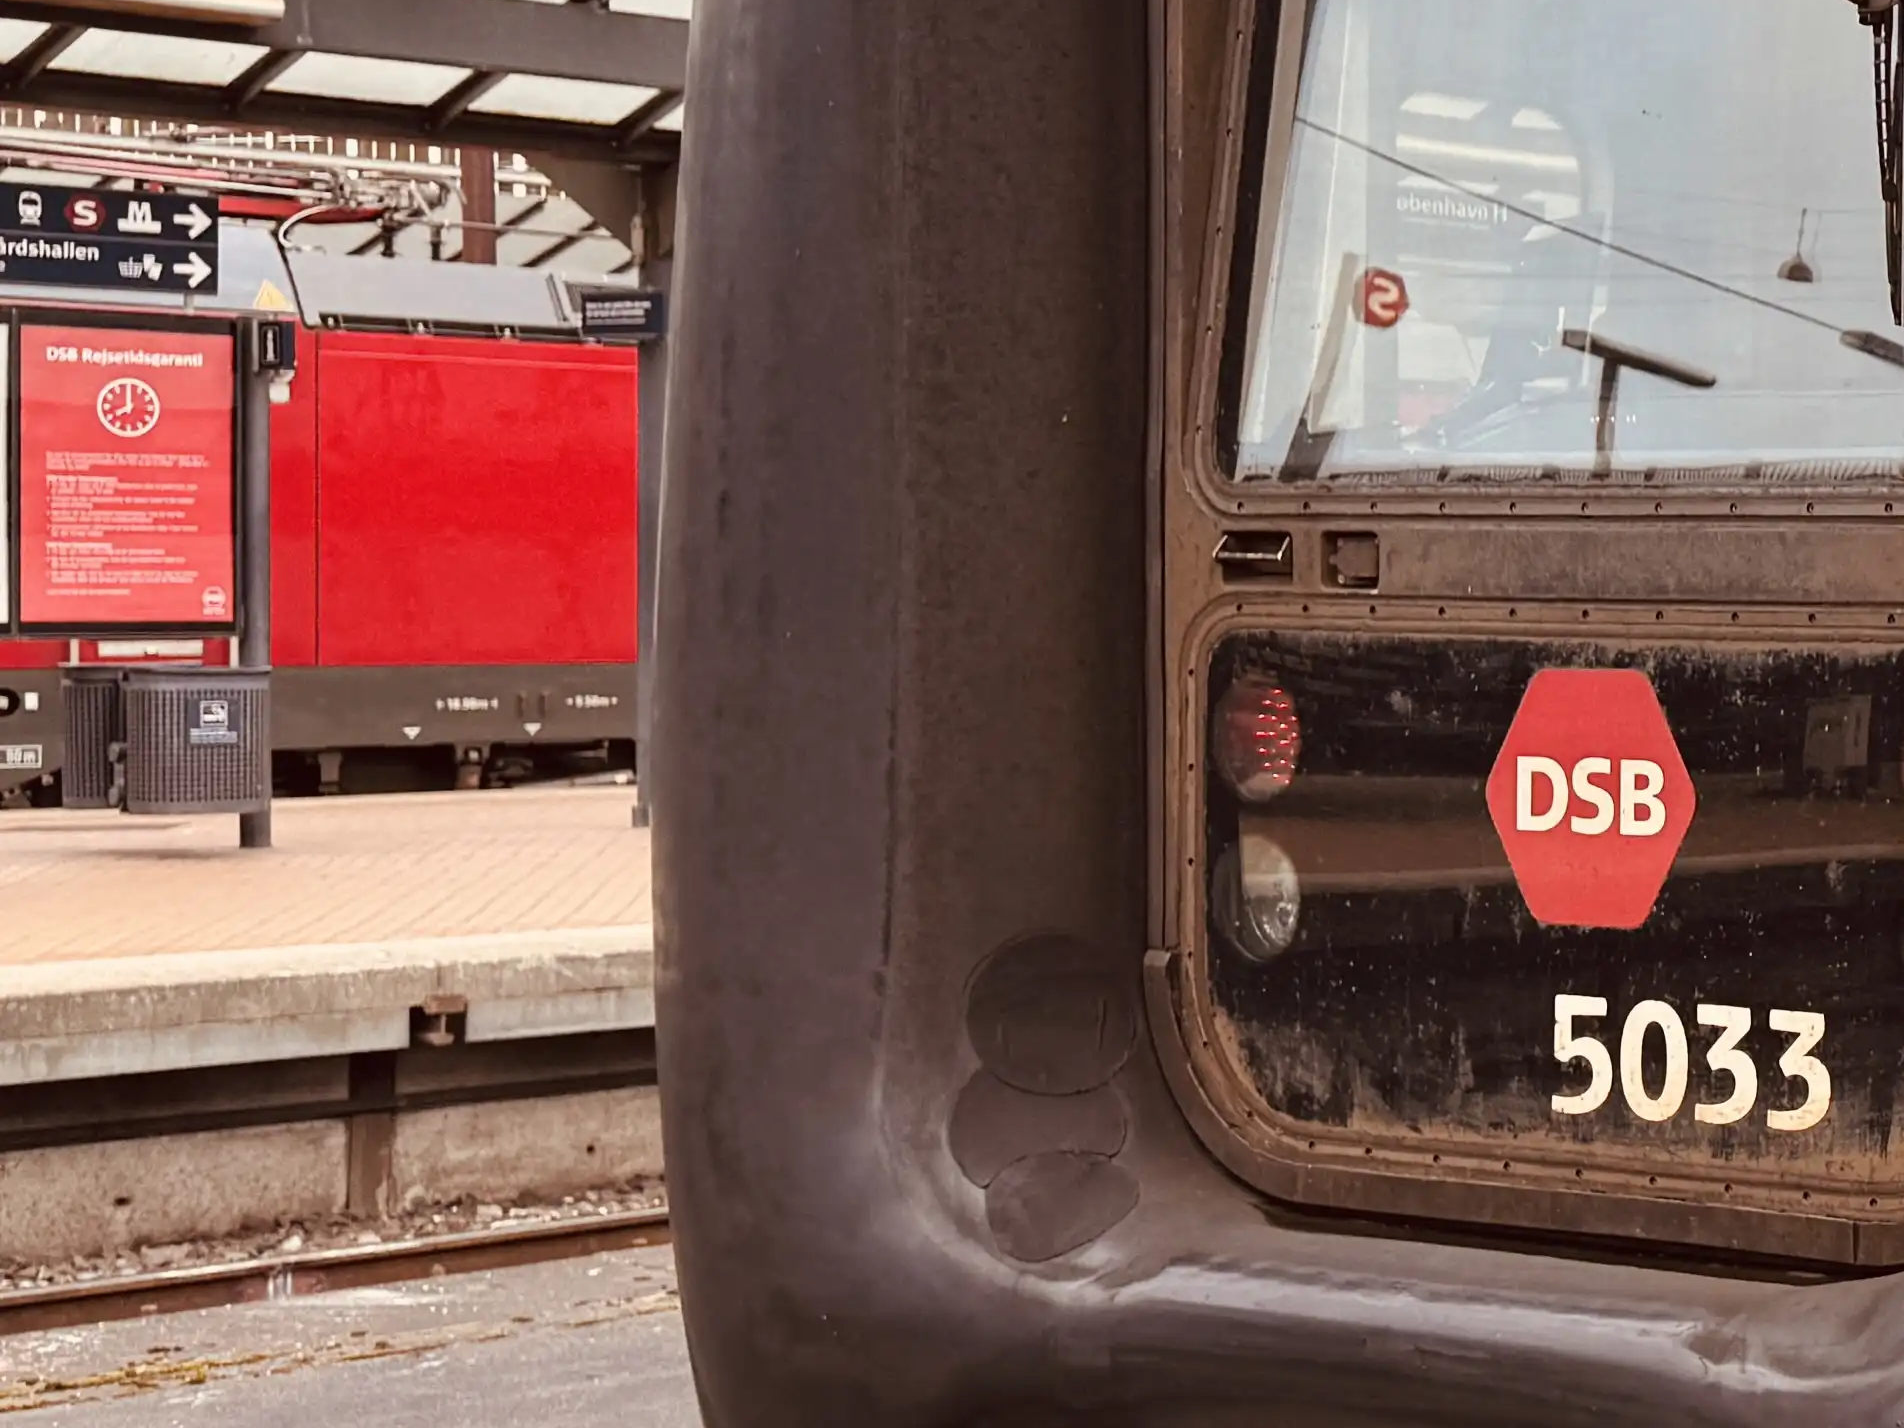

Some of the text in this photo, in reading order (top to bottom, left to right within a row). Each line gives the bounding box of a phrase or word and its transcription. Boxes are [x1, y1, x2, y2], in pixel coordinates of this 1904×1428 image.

[73, 200, 98, 227] S
[46, 346, 78, 363] DSB
[1516, 755, 1667, 837] DSB
[1551, 994, 1833, 1132] 5033
